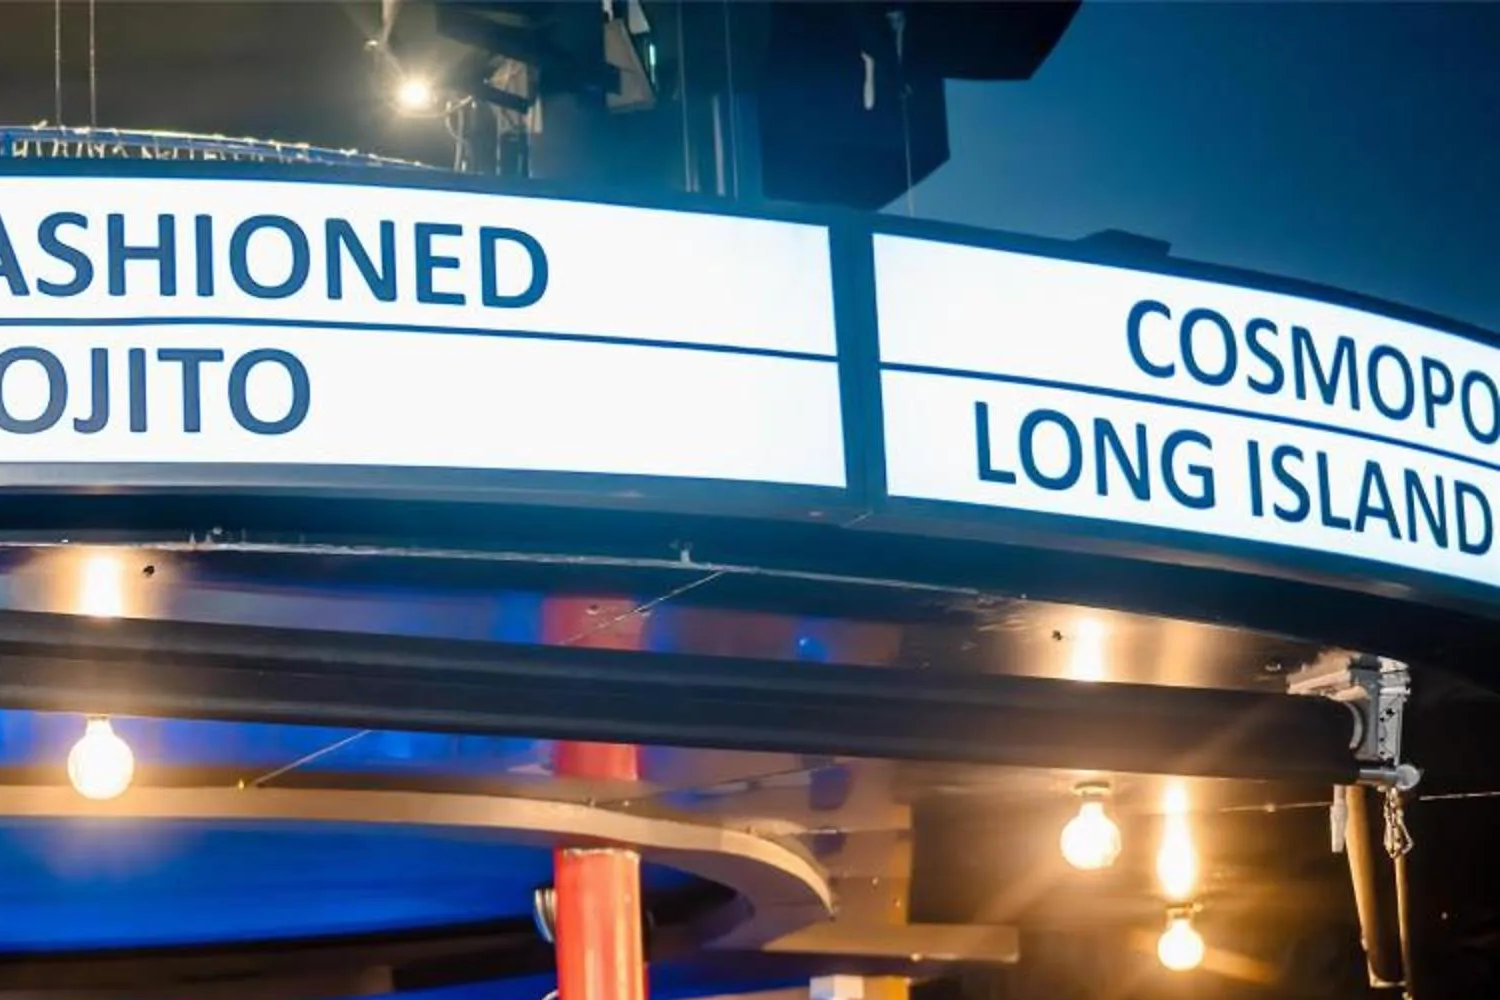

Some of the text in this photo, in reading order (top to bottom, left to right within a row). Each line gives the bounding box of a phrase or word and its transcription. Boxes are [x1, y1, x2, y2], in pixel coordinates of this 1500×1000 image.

[1126, 300, 1500, 444] COSMOPO
[975, 401, 1494, 556] LONG ISLAND
